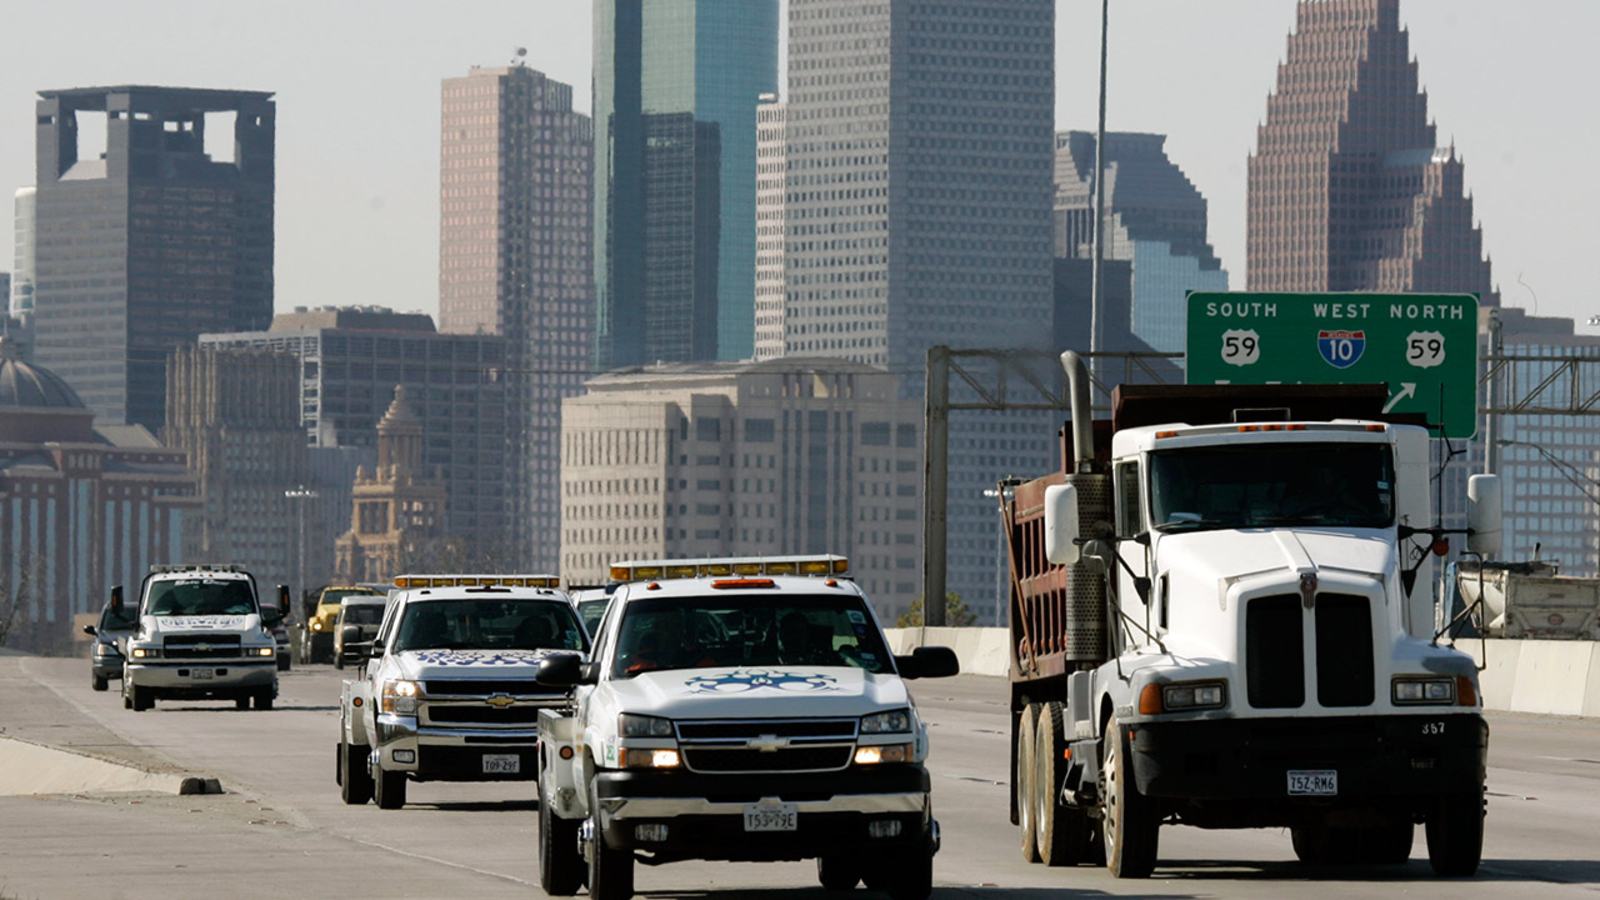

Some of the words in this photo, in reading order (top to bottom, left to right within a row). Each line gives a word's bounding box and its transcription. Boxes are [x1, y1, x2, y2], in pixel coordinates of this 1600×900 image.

[1206, 302, 1277, 318] SOUTH
[1313, 303, 1370, 319] WEST
[1389, 304, 1463, 320] NORTH
[1226, 336, 1256, 357] 59
[1329, 339, 1354, 361] 10
[1410, 339, 1442, 359] 59
[1421, 721, 1446, 735] 357
